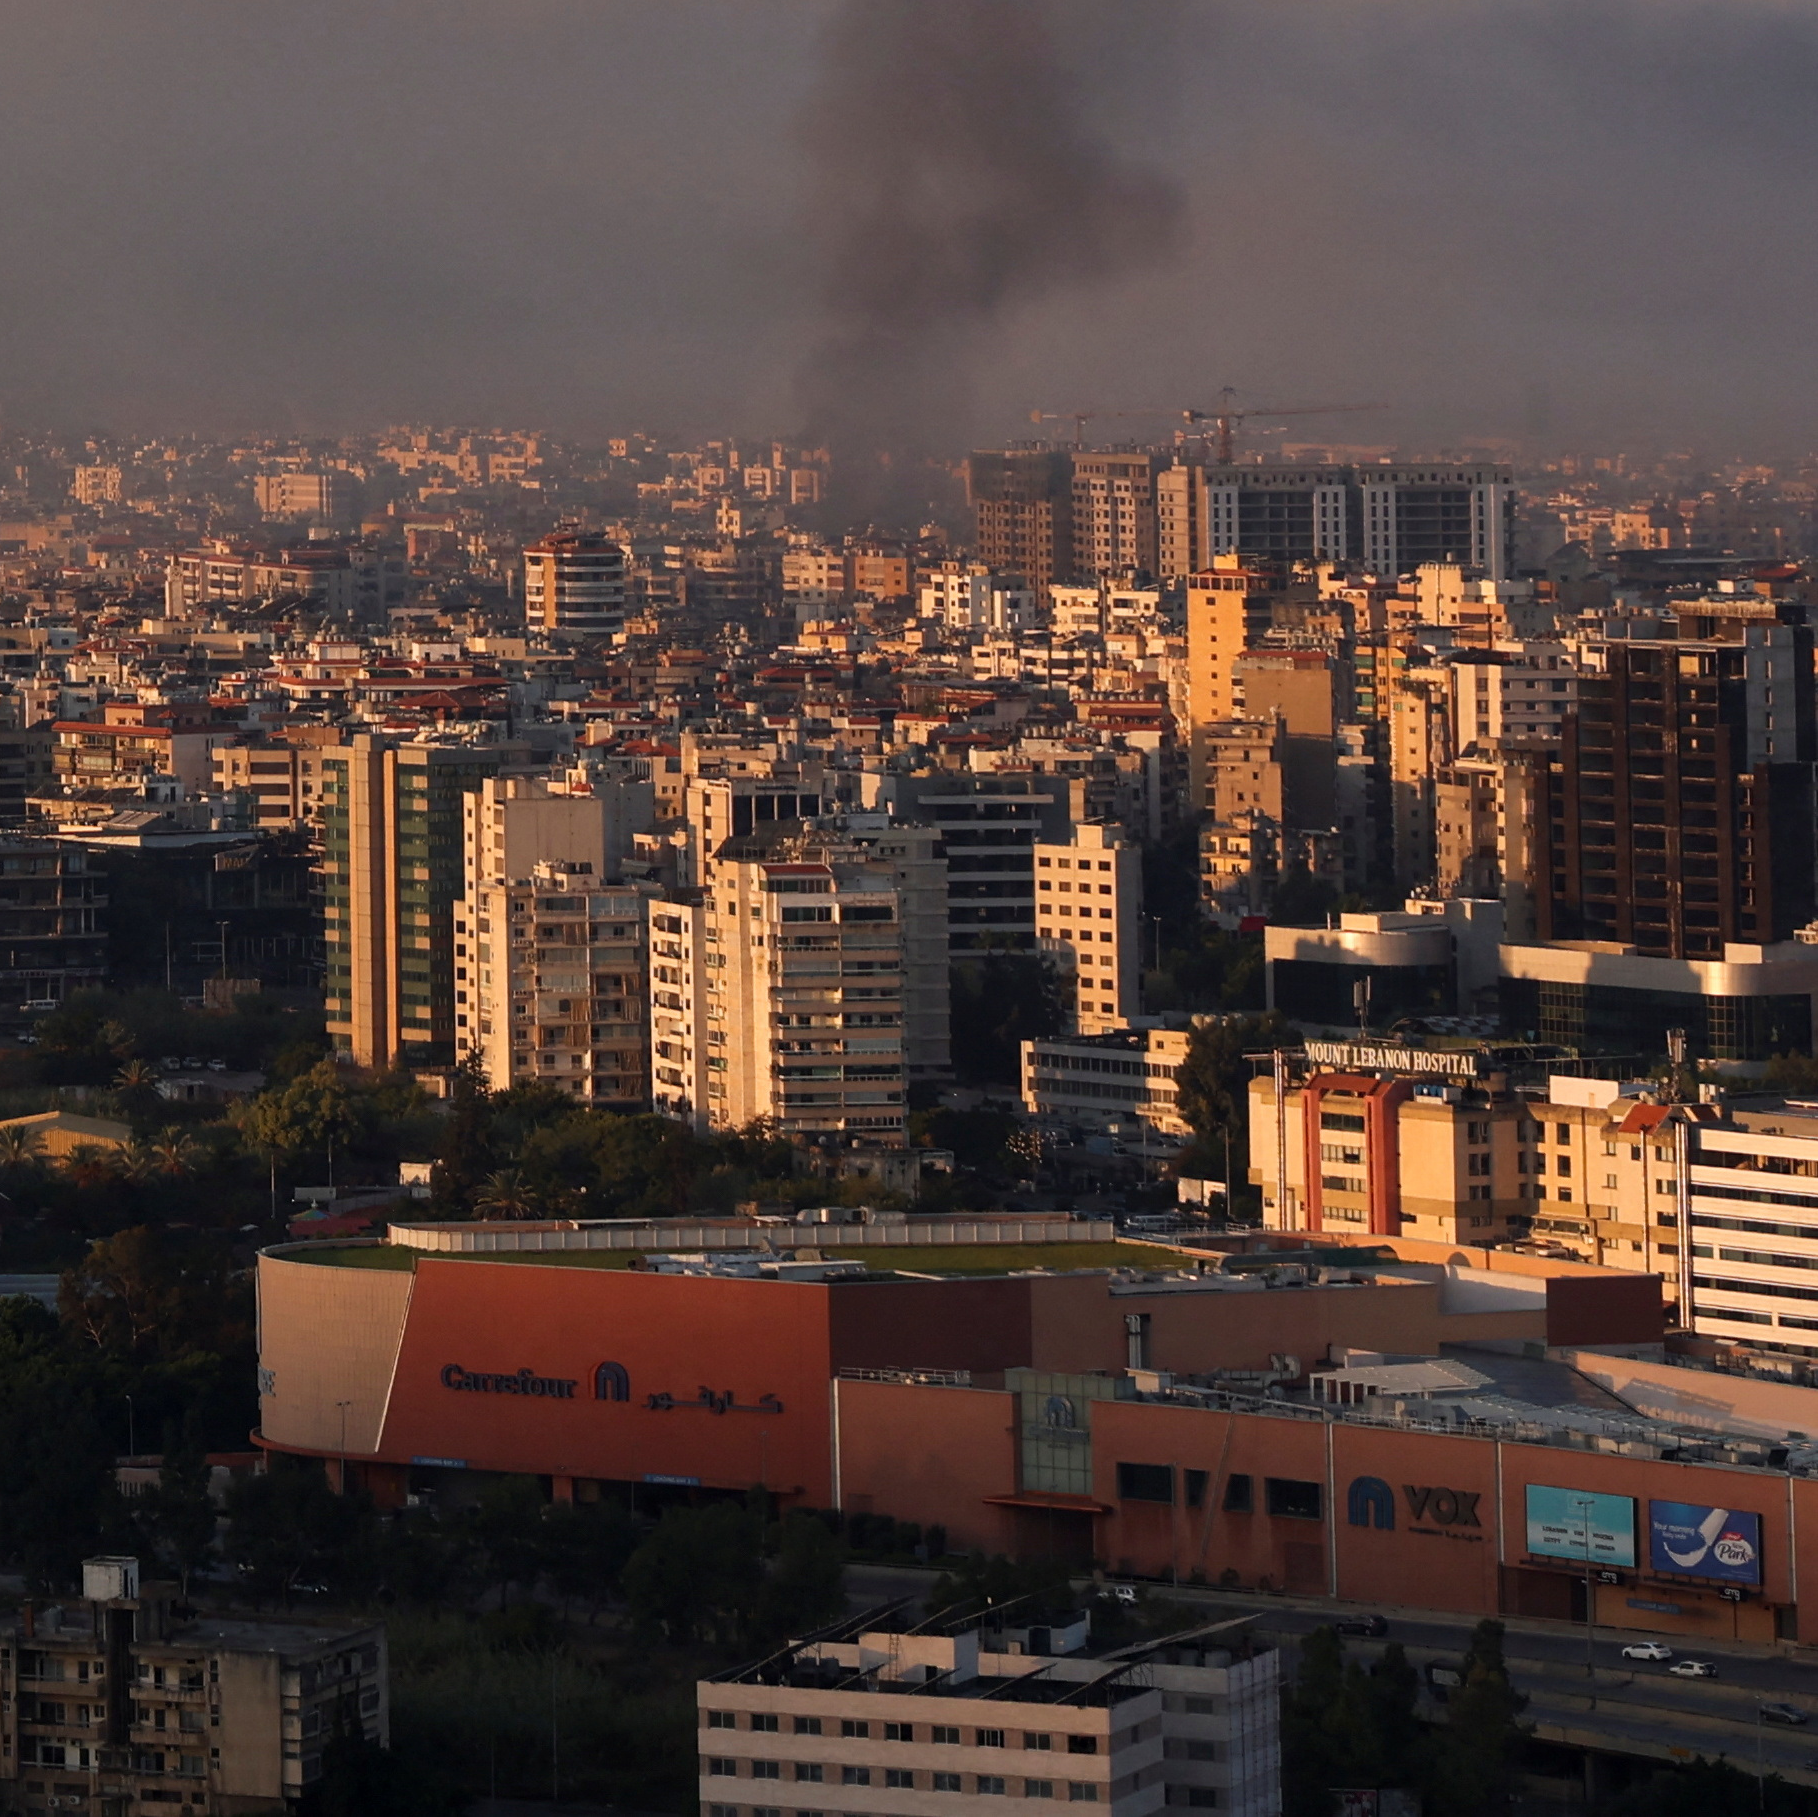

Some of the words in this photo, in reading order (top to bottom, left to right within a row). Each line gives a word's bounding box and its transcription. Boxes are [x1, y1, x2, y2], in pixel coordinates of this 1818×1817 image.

[1305, 1042, 1350, 1065] MOUNT
[1353, 1046, 1410, 1071] LEBANON
[1414, 1051, 1477, 1076] HOSPITAL
[441, 1363, 578, 1399] Carrefour
[1402, 1484, 1481, 1527] VOX
[1717, 1543, 1747, 1563] Park
